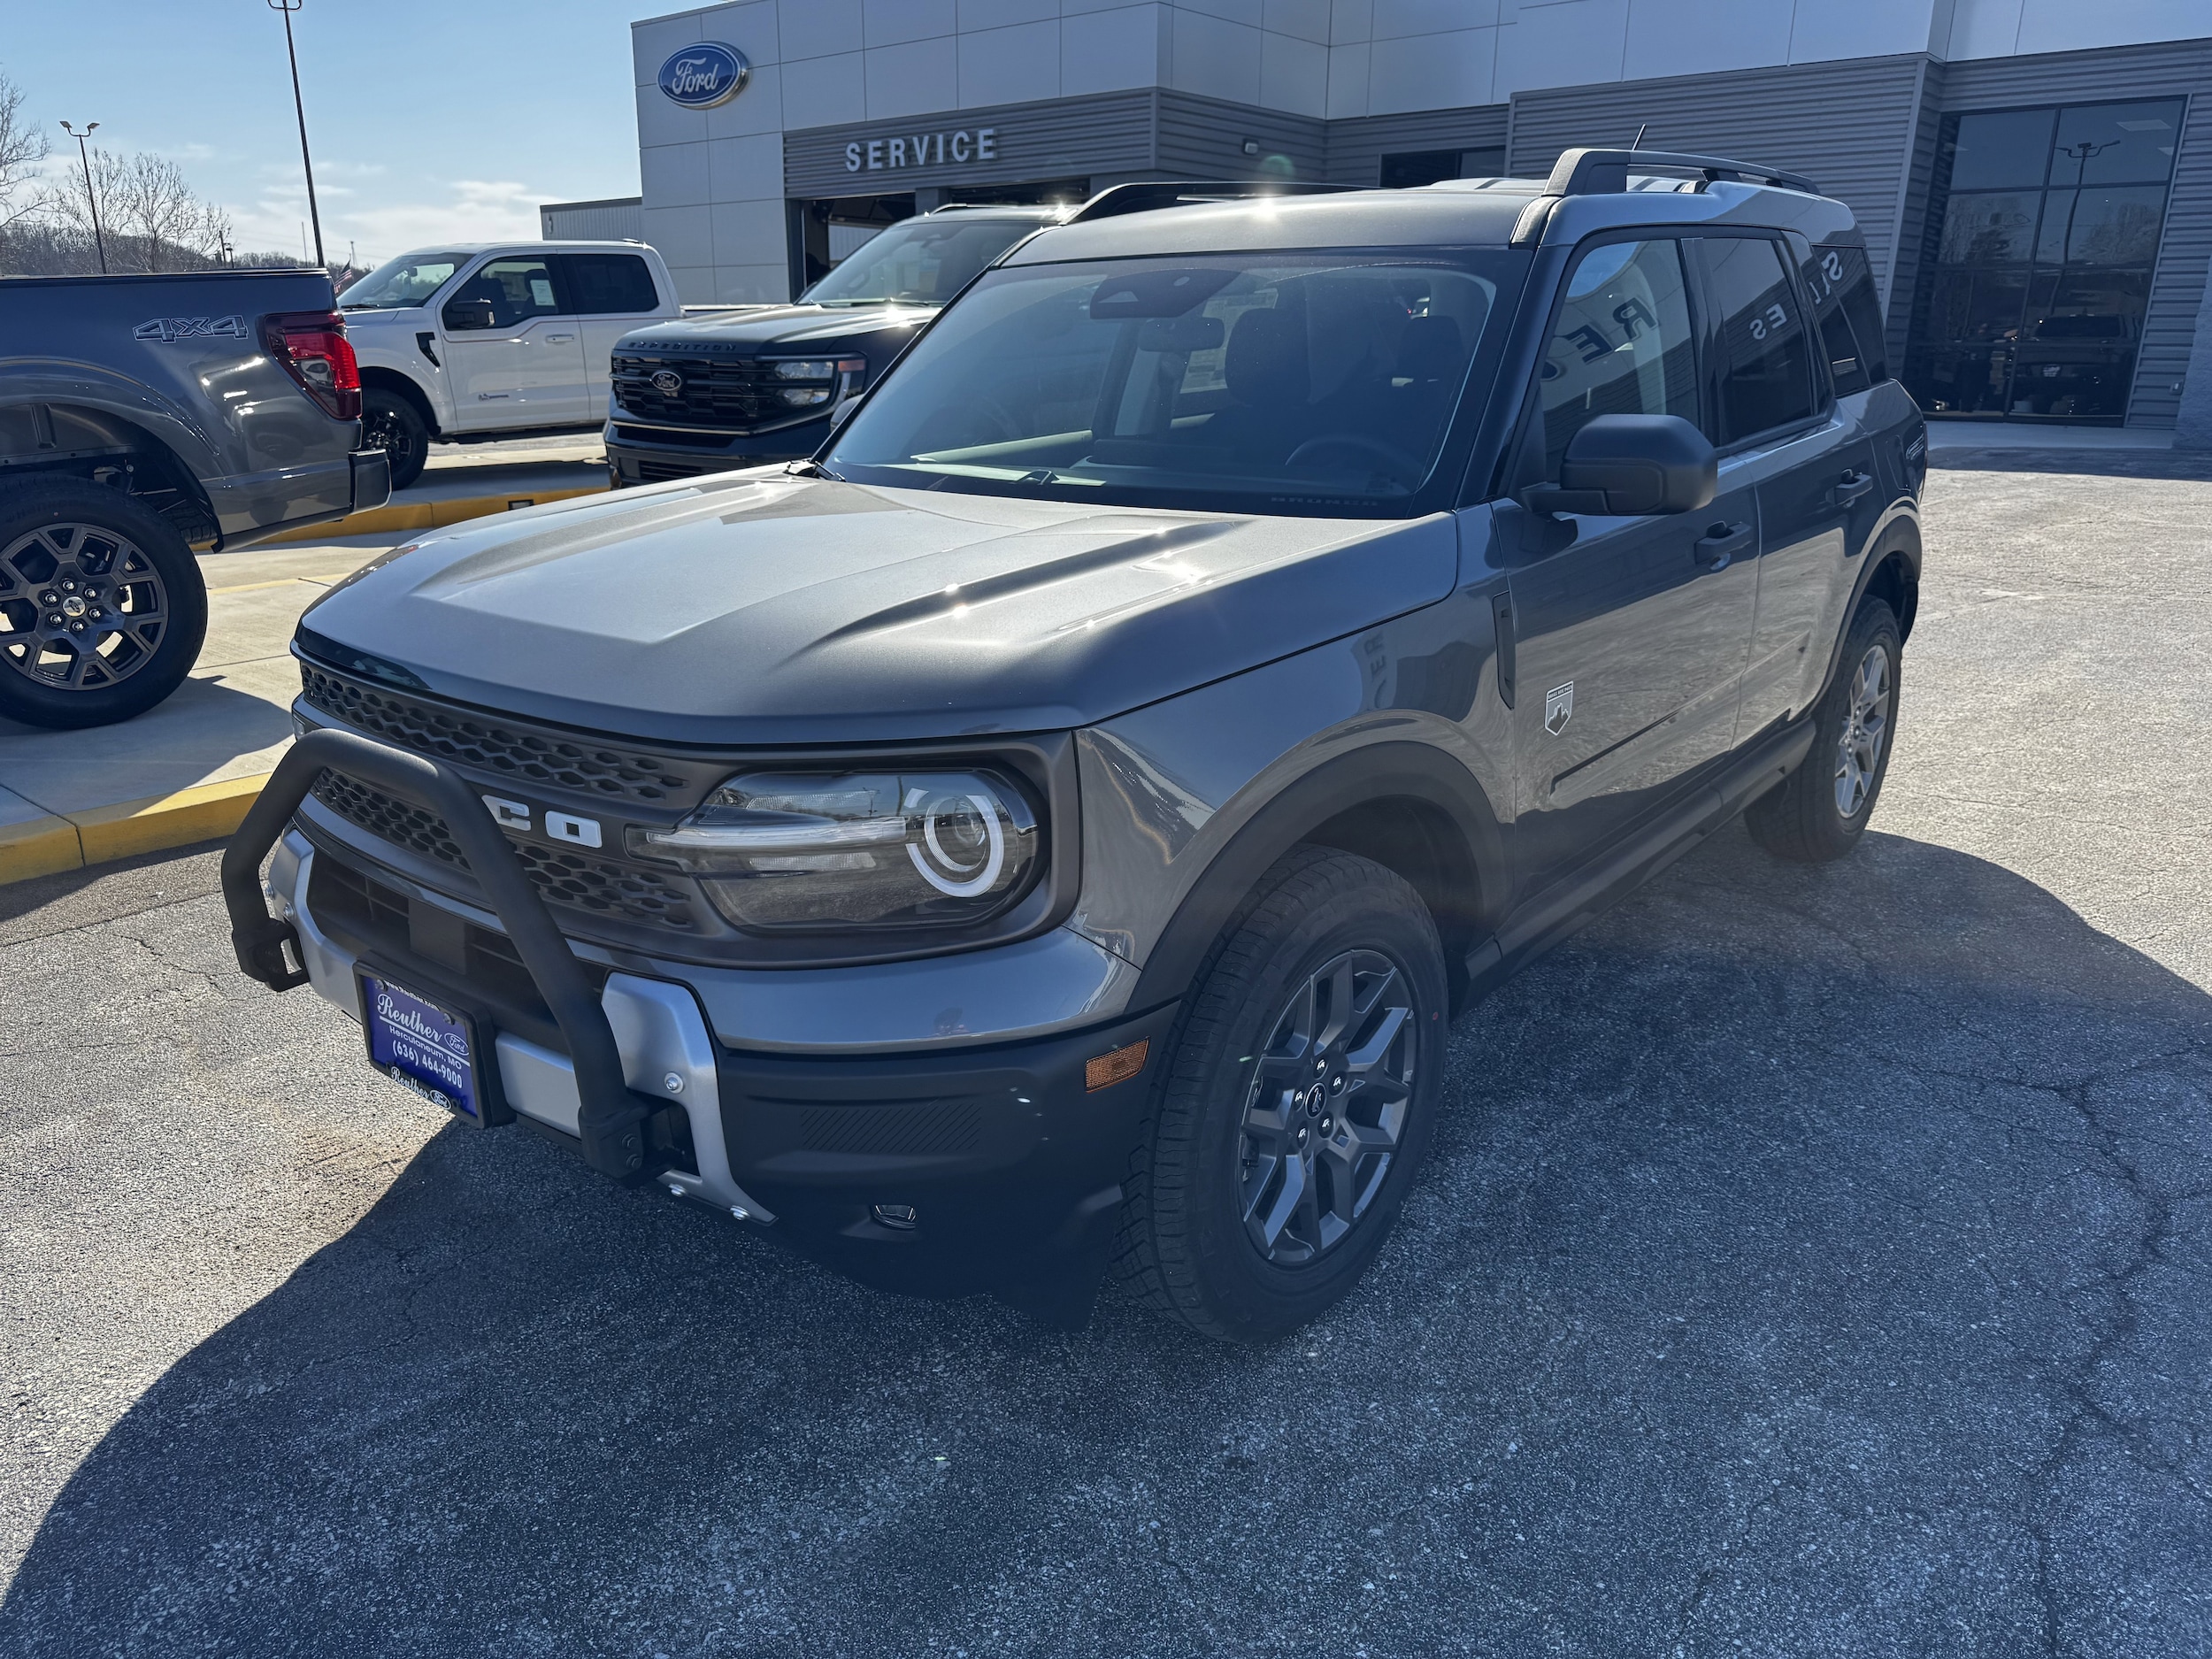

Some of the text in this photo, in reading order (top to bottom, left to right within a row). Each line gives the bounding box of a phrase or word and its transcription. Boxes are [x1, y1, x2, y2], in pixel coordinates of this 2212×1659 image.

[672, 57, 719, 95] Ford
[846, 128, 995, 172] SERVICE
[627, 341, 736, 351] EXPEDITION
[657, 373, 675, 388] Ford
[377, 994, 442, 1042] Reuther
[449, 1036, 465, 1053] Ford
[392, 1040, 463, 1089] (636) 464-9000
[447, 1056, 462, 1070] MO
[391, 1066, 429, 1099] Reuther
